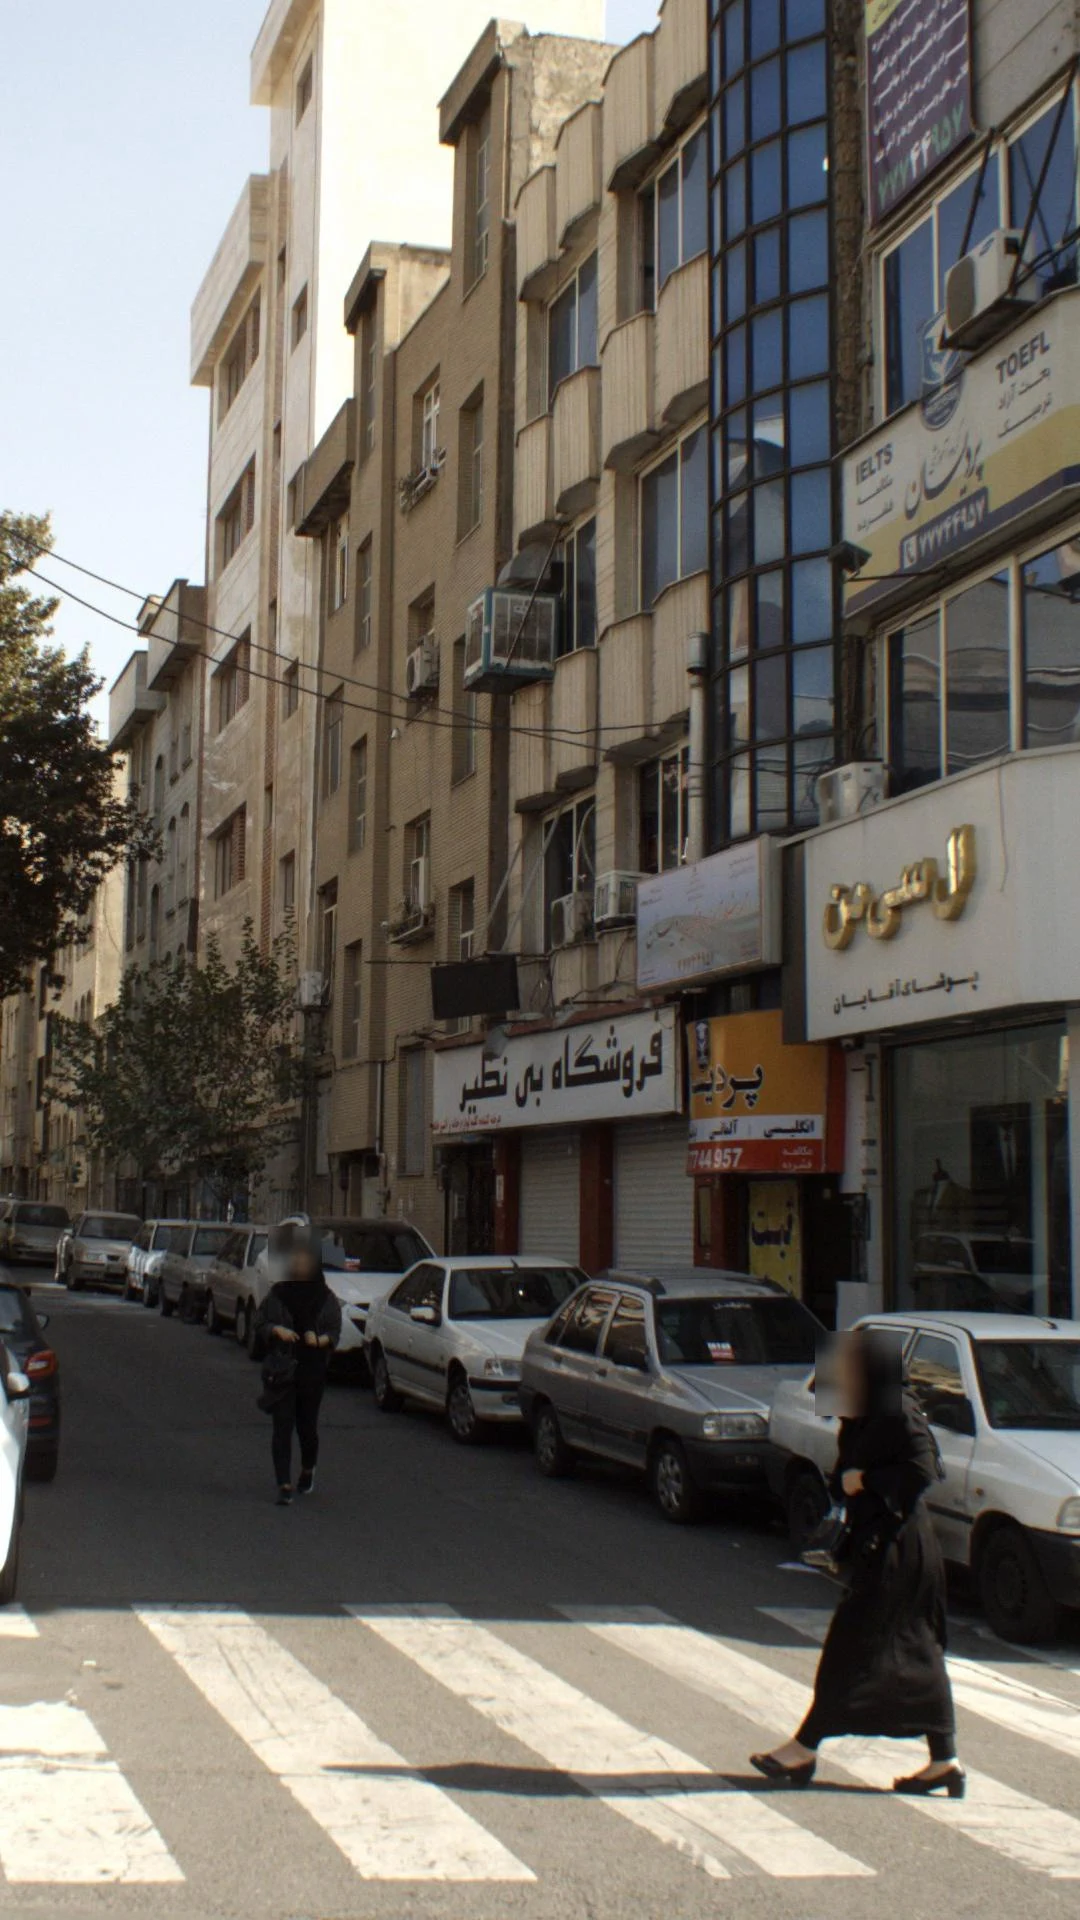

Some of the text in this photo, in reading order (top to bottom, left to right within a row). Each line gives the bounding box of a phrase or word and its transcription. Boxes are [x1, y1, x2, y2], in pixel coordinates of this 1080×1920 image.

[995, 332, 1050, 384] TOEFL
[855, 443, 893, 486] IELTS
[834, 978, 900, 1015] آقایان
[459, 1011, 663, 1115] فروشگاه بی نظیر
[764, 1117, 815, 1138] انگلیسی
